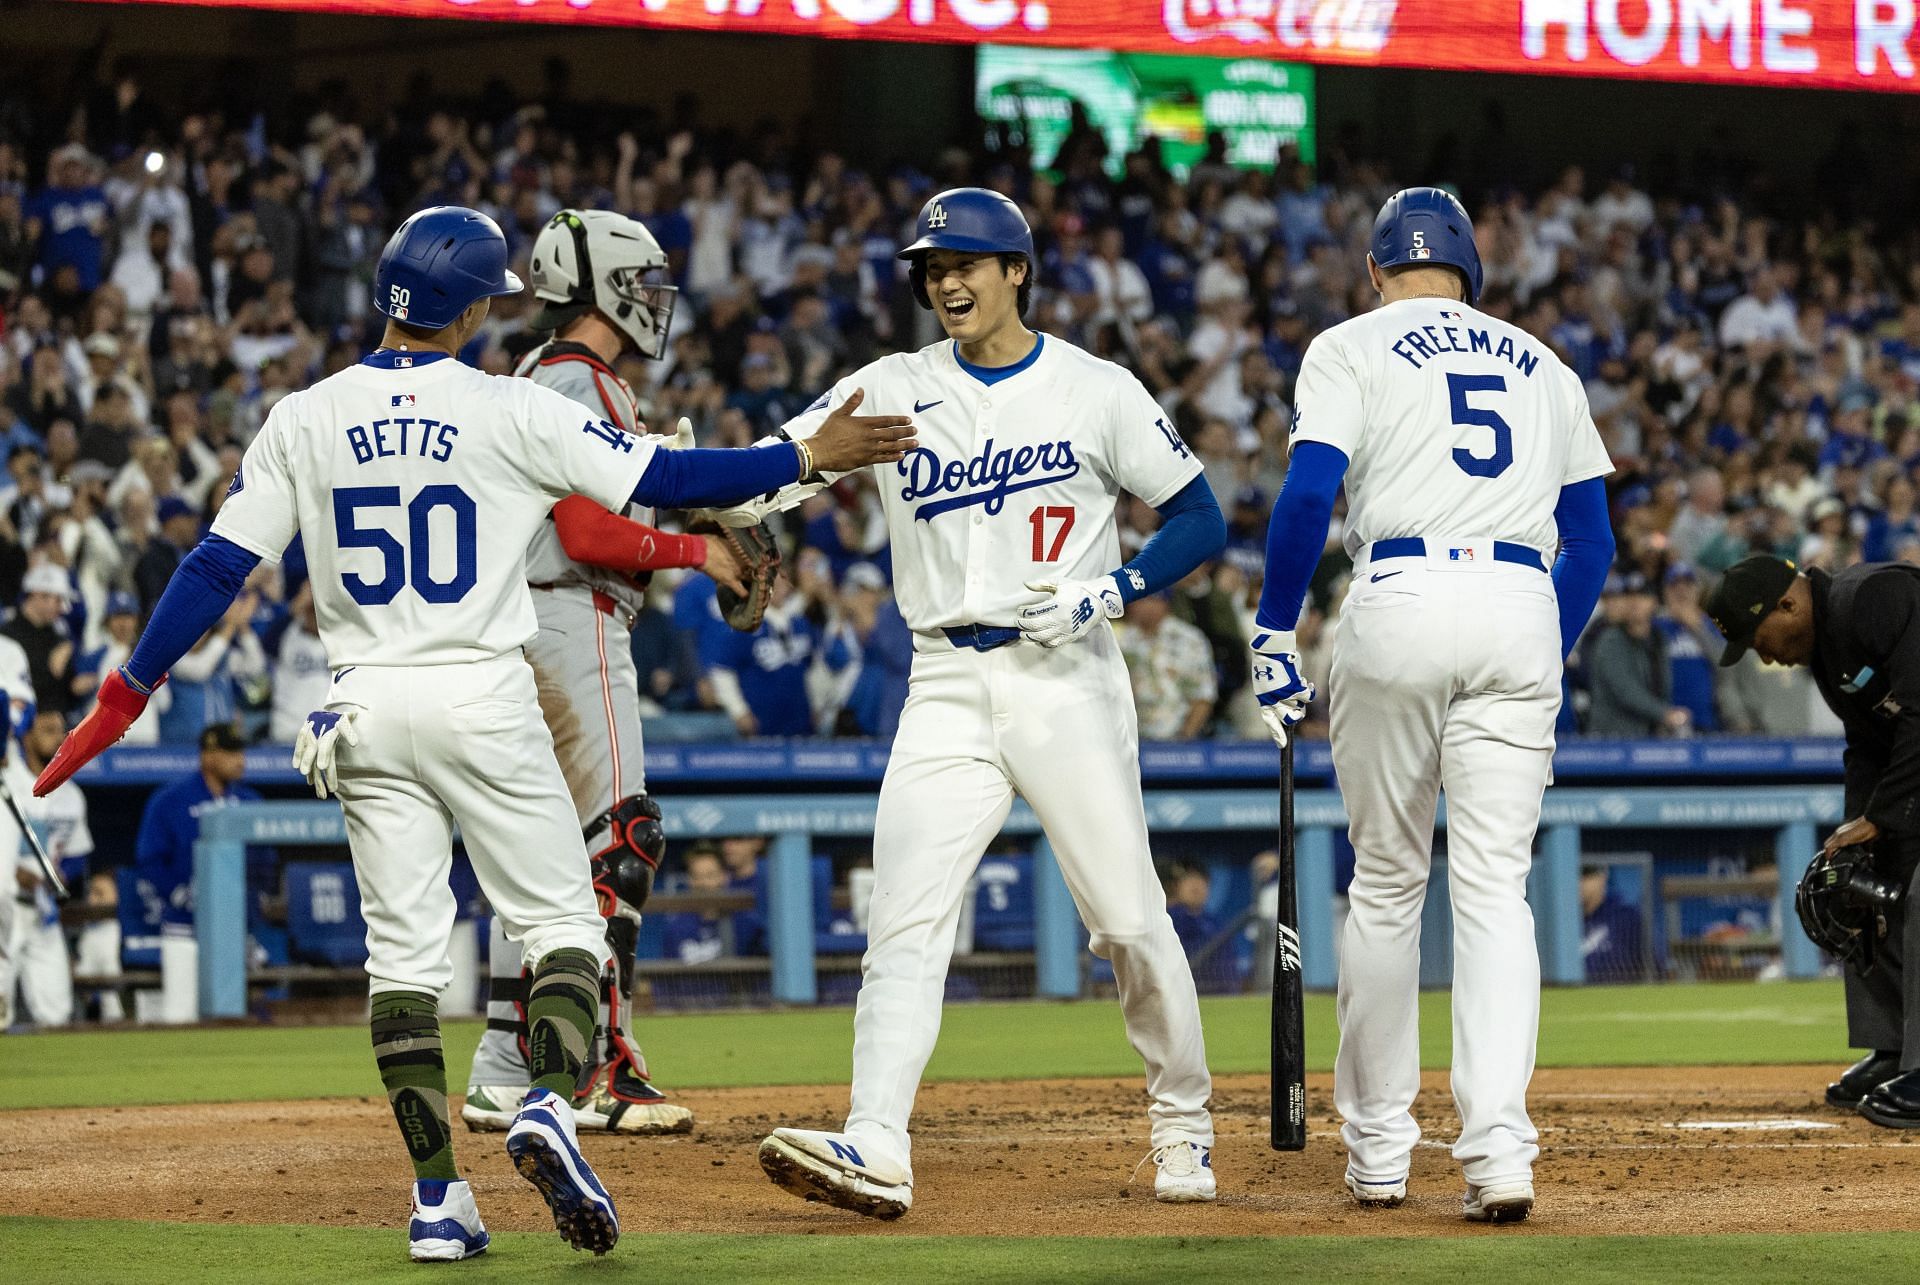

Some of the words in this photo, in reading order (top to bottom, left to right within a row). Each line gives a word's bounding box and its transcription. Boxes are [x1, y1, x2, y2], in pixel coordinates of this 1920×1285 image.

[1520, 0, 1819, 73] HOME
[928, 199, 948, 229] LA
[1413, 231, 1425, 248] 5
[389, 284, 411, 307] 50
[1391, 325, 1539, 378] FREEMAN
[346, 418, 459, 465] BETTS
[1445, 372, 1514, 479] 5
[897, 438, 1080, 516] Dodgers
[332, 484, 478, 606] 50
[1028, 505, 1076, 563] 17
[1036, 603, 1059, 615] balance
[1278, 930, 1290, 972] marucci
[532, 1027, 548, 1072] USA
[401, 1101, 430, 1150] USA
